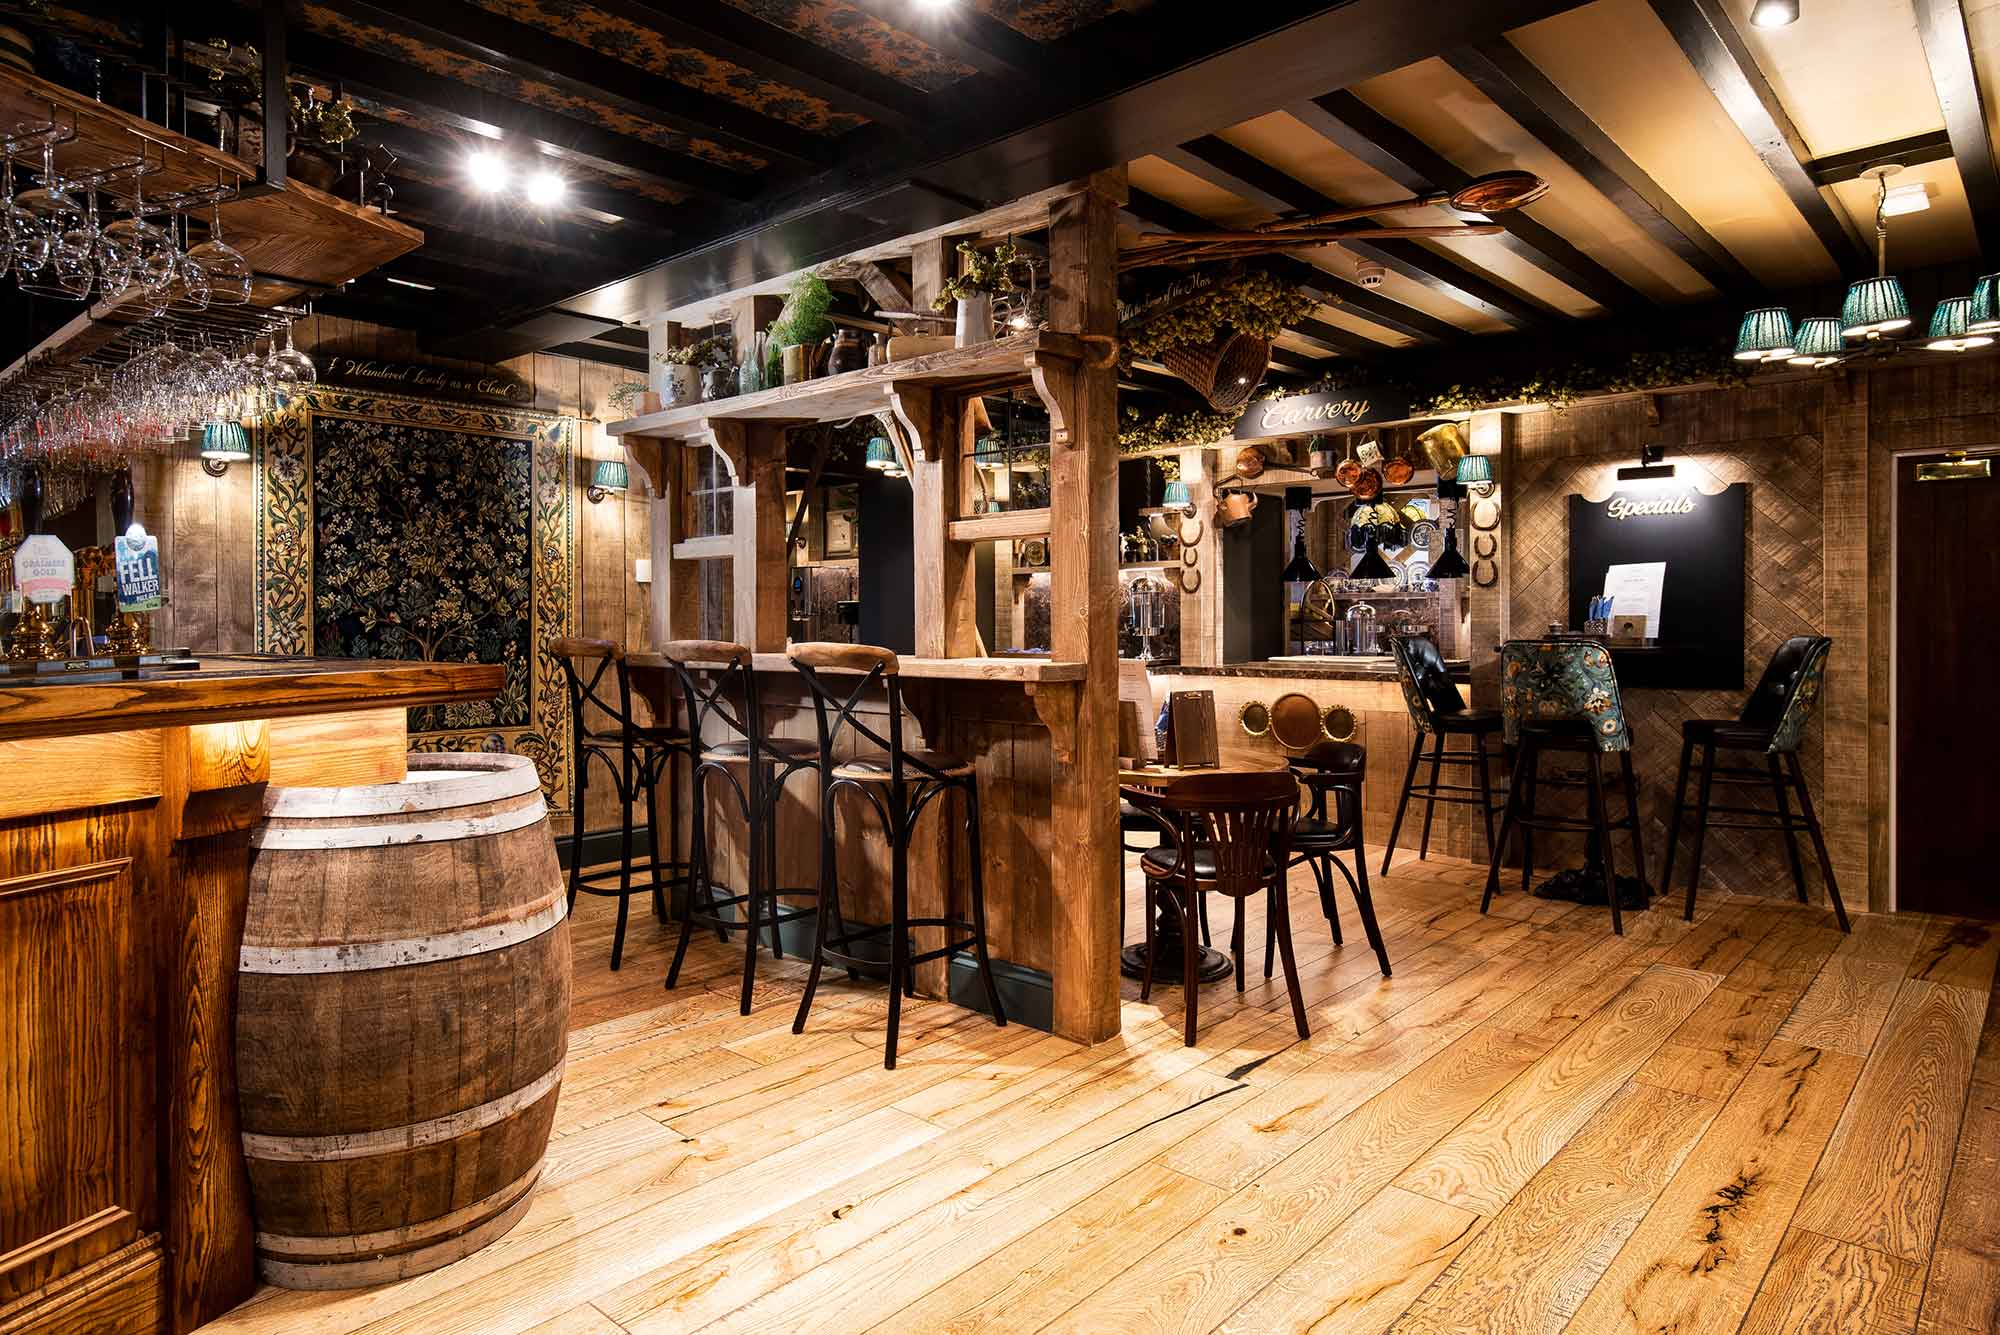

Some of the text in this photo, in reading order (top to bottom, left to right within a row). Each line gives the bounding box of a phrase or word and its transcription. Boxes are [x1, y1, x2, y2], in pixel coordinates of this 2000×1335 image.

[344, 359, 414, 381] Wandered
[464, 382, 472, 390] a
[476, 378, 521, 397] Cloud
[1261, 399, 1371, 429] Carvery
[1607, 494, 1696, 520] Specials
[119, 556, 158, 585] FELL
[122, 579, 160, 597] WALKER
